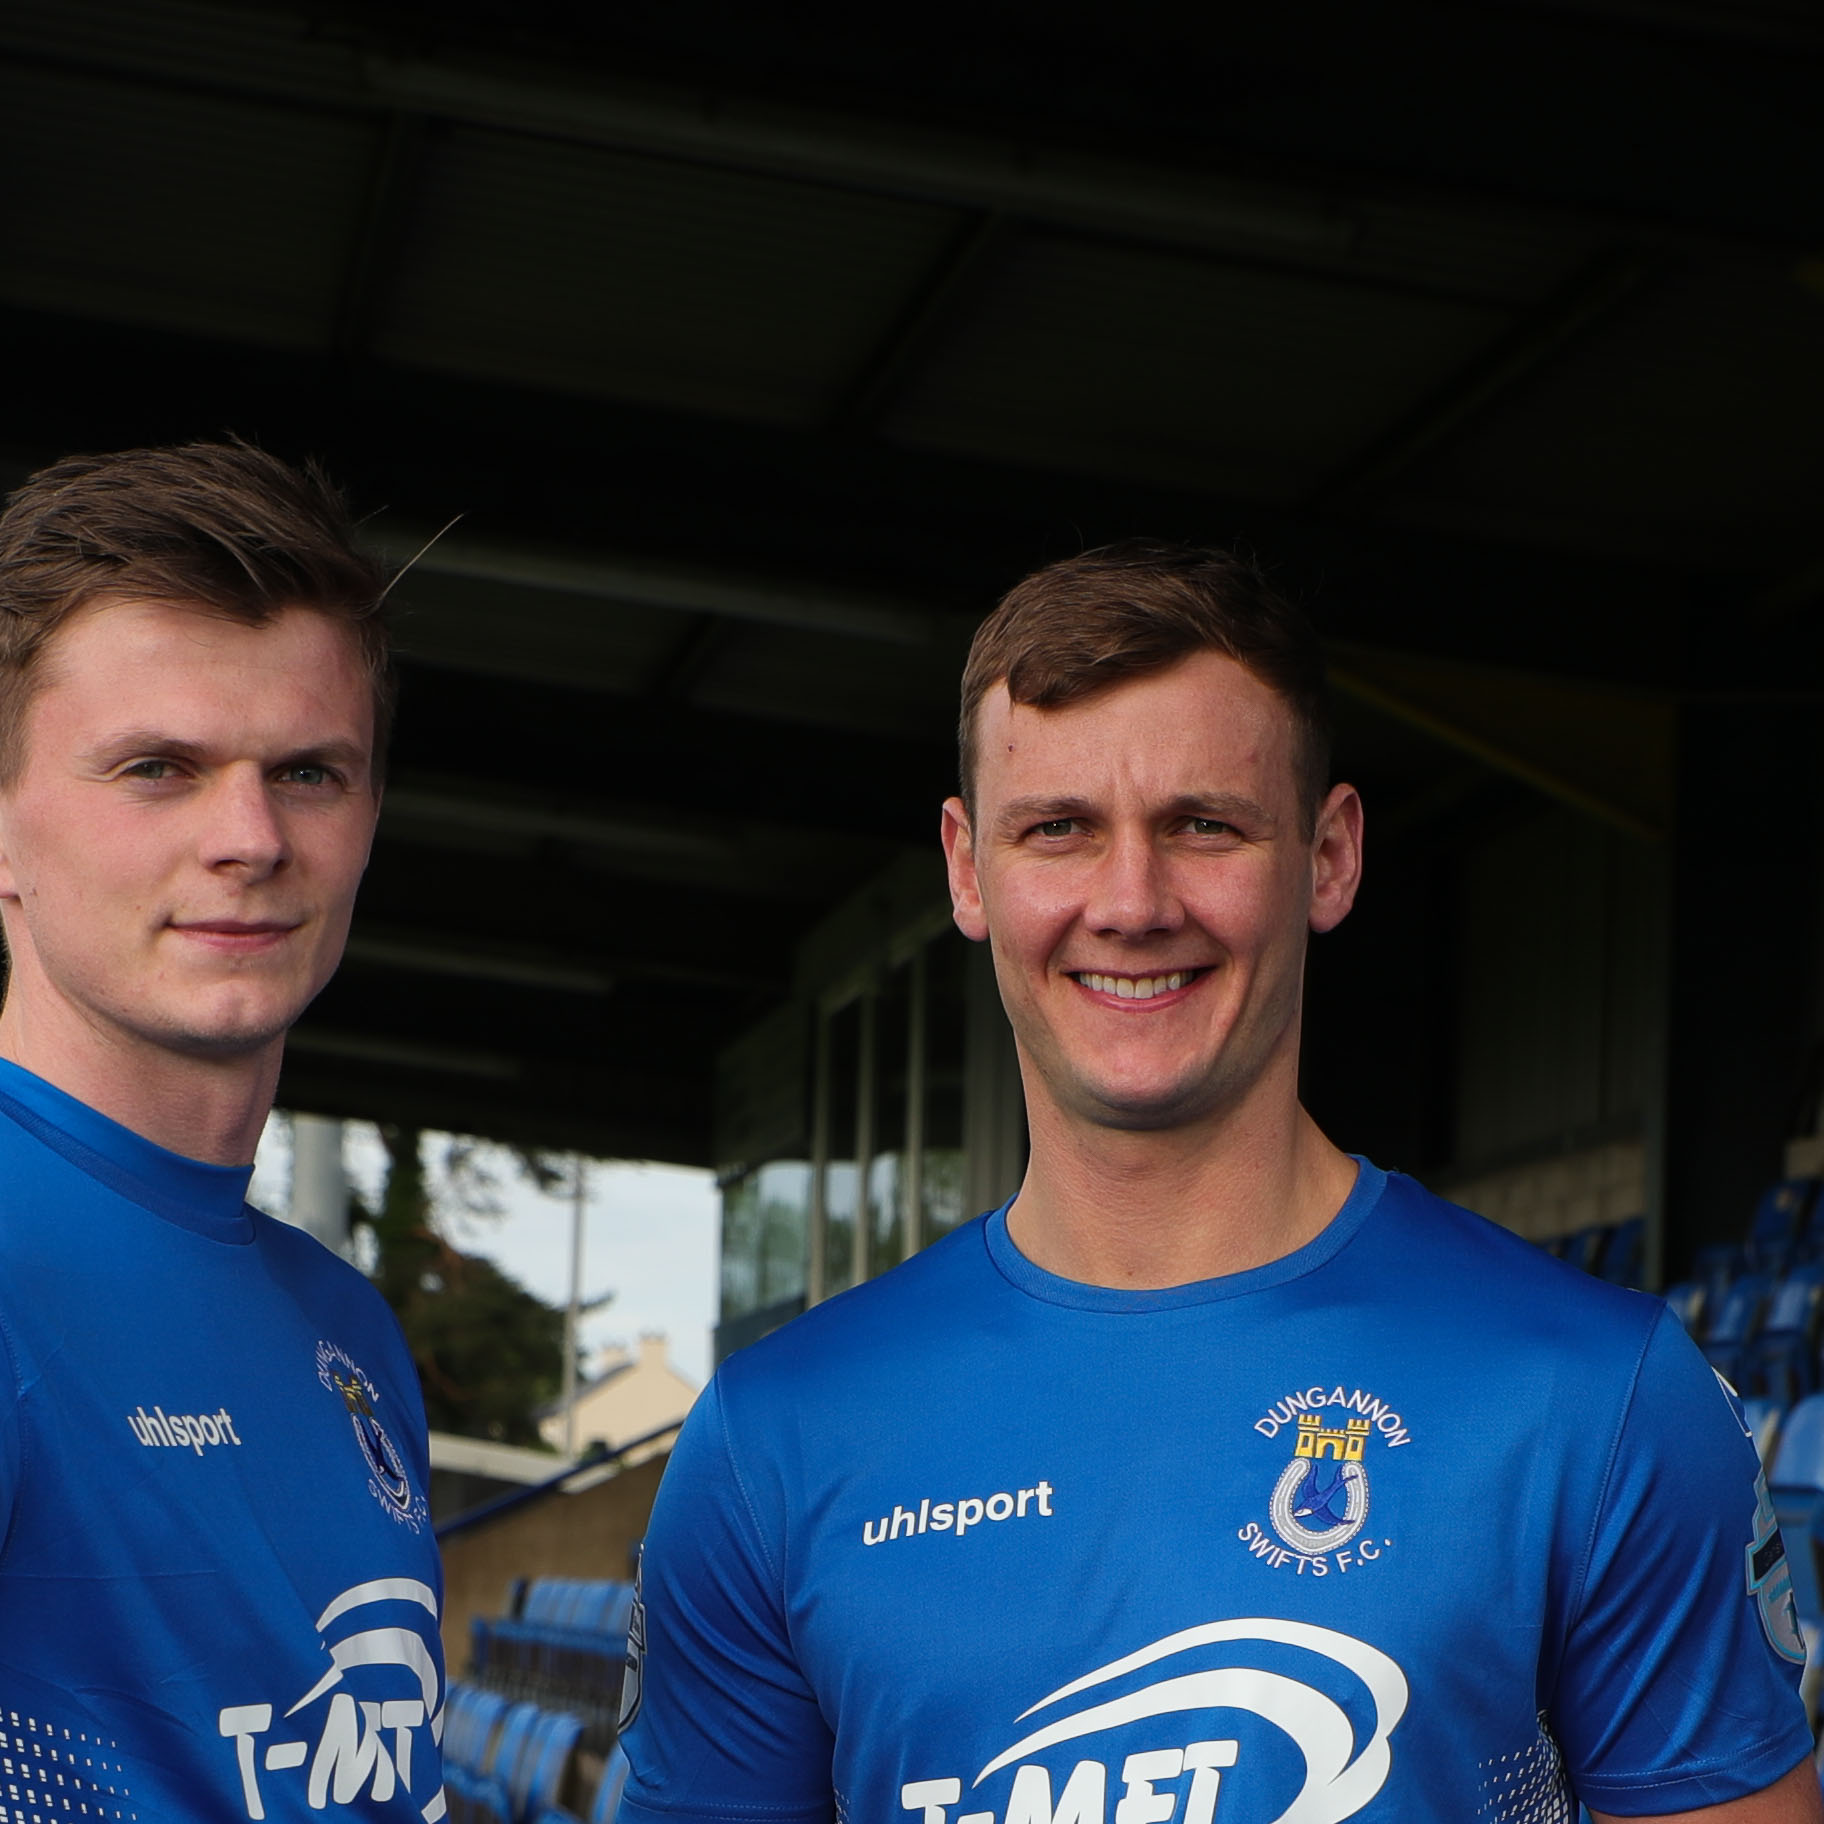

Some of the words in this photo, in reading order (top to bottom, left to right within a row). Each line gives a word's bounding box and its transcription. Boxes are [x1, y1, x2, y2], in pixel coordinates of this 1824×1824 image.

[127, 1406, 242, 1456] uhlsport
[1254, 1386, 1411, 1448] DUNGANNON
[862, 1480, 1053, 1546] uhlsport
[1238, 1522, 1329, 1577] SWIFTS
[1336, 1538, 1392, 1574] F.C.
